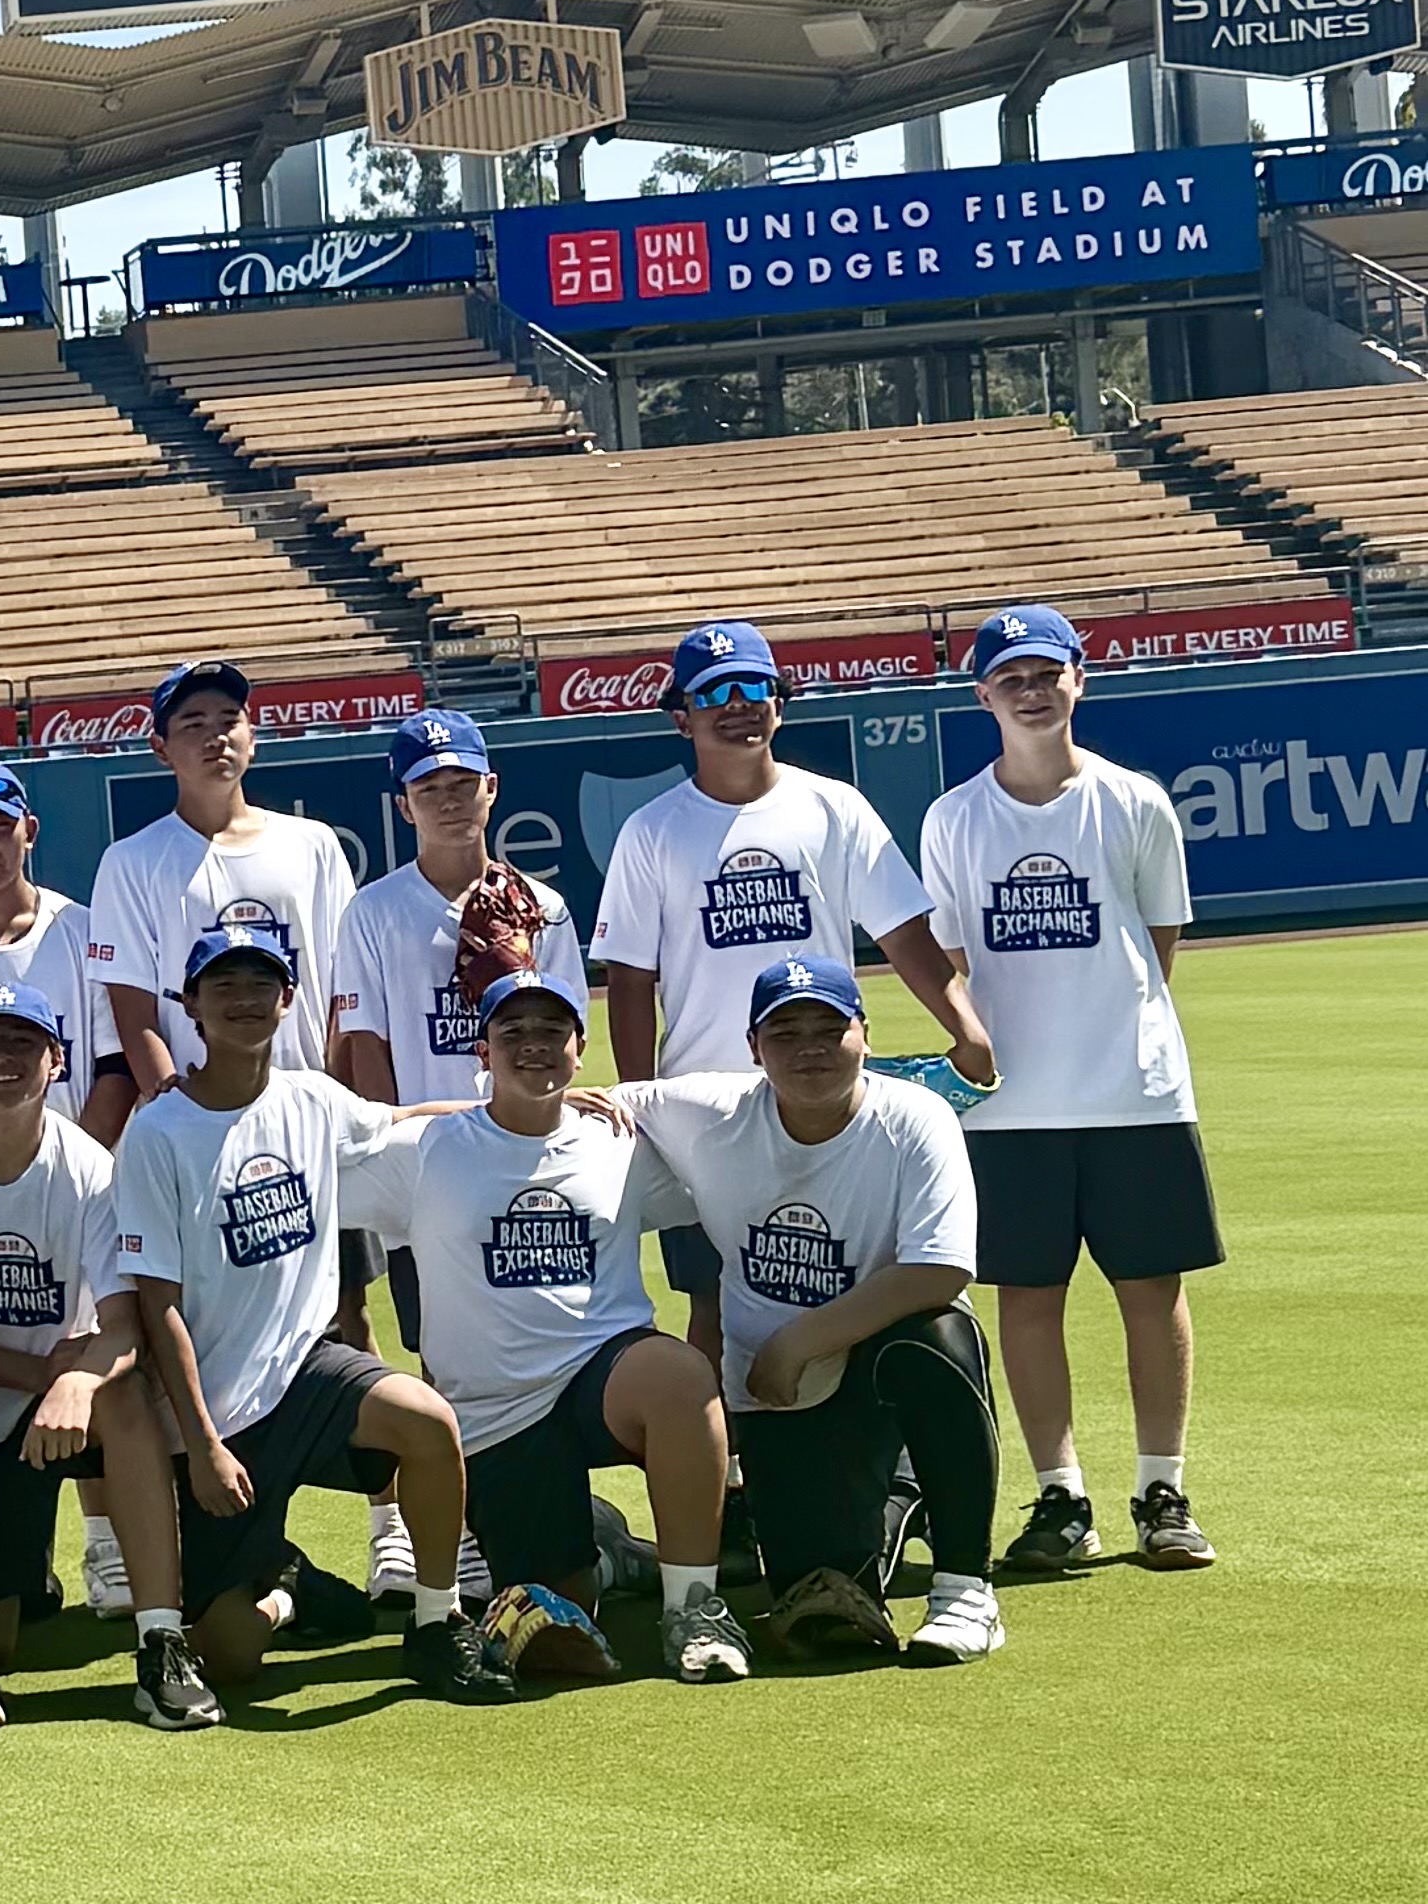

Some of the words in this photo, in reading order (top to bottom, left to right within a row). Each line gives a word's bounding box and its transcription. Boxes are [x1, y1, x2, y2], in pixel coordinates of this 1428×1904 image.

[1212, 13, 1370, 48] AIRLINES
[386, 53, 468, 136] JIM
[473, 31, 604, 114] BEAM
[726, 201, 931, 243] UNIQLO
[965, 185, 1106, 222] FIELD
[1140, 177, 1196, 209] AT
[730, 245, 940, 291] DODGER
[975, 223, 1209, 269] STADIUM
[1106, 639, 1124, 659] A
[1133, 634, 1178, 657] HIT
[1186, 626, 1273, 652] EVERY
[1279, 620, 1348, 643] TIME
[839, 656, 918, 679] MAGIC
[259, 699, 346, 726] EVERY
[352, 693, 419, 718] TIME
[863, 715, 926, 747] 375
[714, 878, 794, 907] BASEBALL
[1000, 882, 1083, 911] BASEBALL
[710, 903, 804, 939] EXCHANGE
[992, 908, 1092, 942] EXCHANGE
[233, 1179, 304, 1223] BASEBALL
[232, 1207, 310, 1258] EXCHANGE
[500, 1223, 581, 1245] BASEBALL
[493, 1246, 589, 1278] EXCHANGE
[755, 1233, 836, 1269] BASEBALL
[748, 1259, 845, 1296] EXCHANGE
